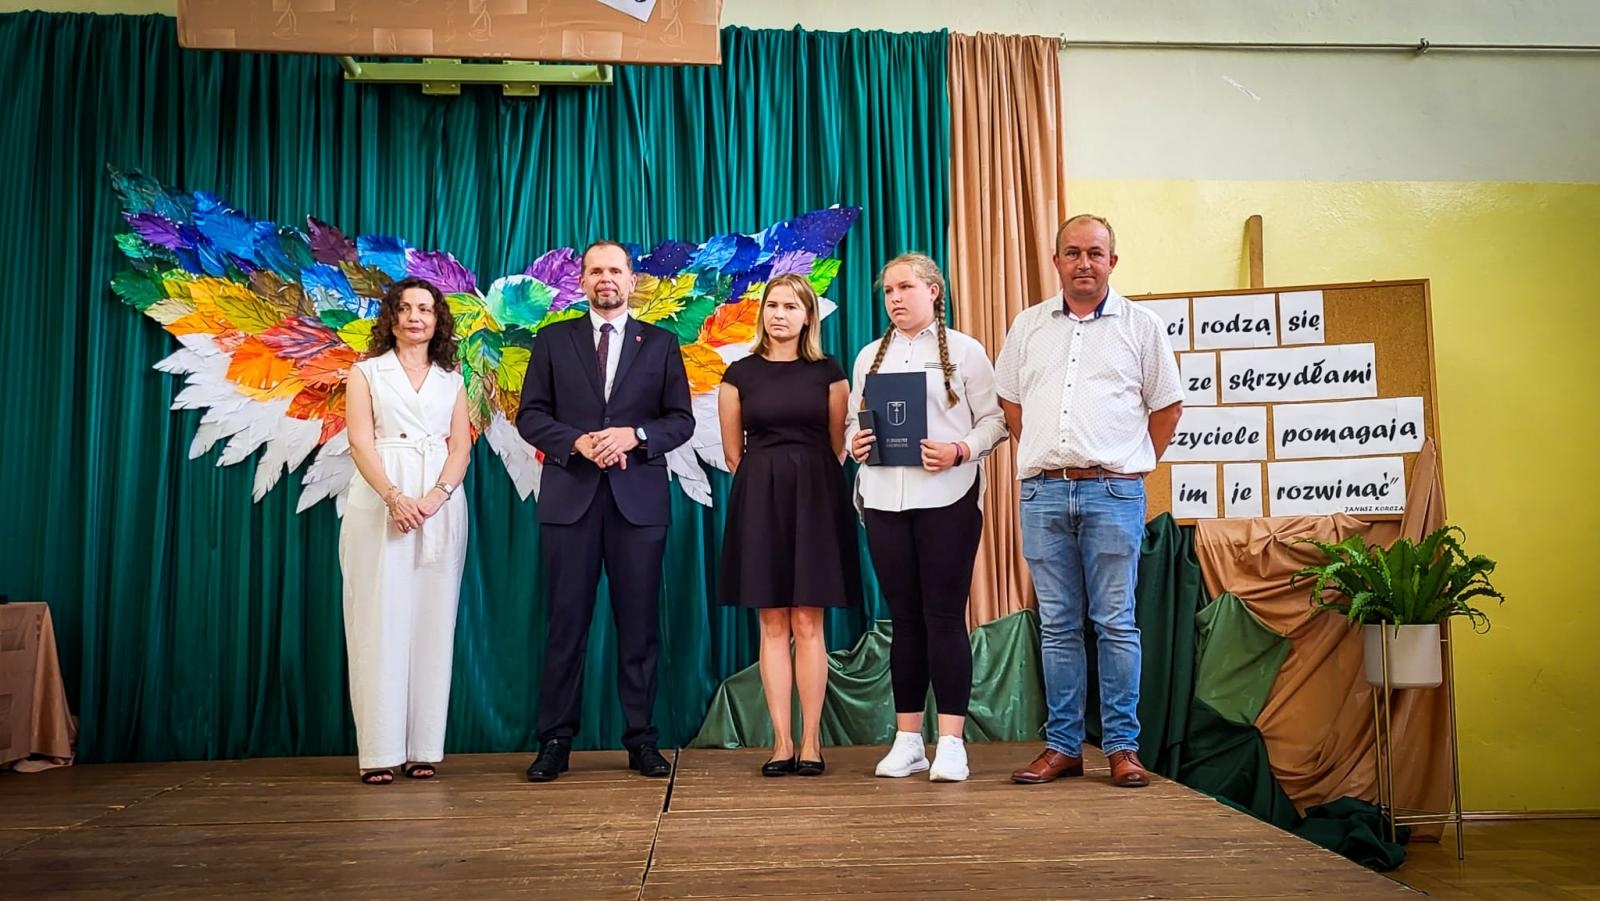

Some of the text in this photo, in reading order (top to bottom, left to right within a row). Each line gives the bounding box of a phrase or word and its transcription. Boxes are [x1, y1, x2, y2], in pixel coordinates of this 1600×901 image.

[1201, 313, 1271, 336] rodzą
[1288, 310, 1320, 331] się
[1188, 359, 1372, 391] ze skrzydłami
[1282, 418, 1418, 447] pomagają
[1179, 483, 1207, 504] im
[1231, 482, 1252, 505] je
